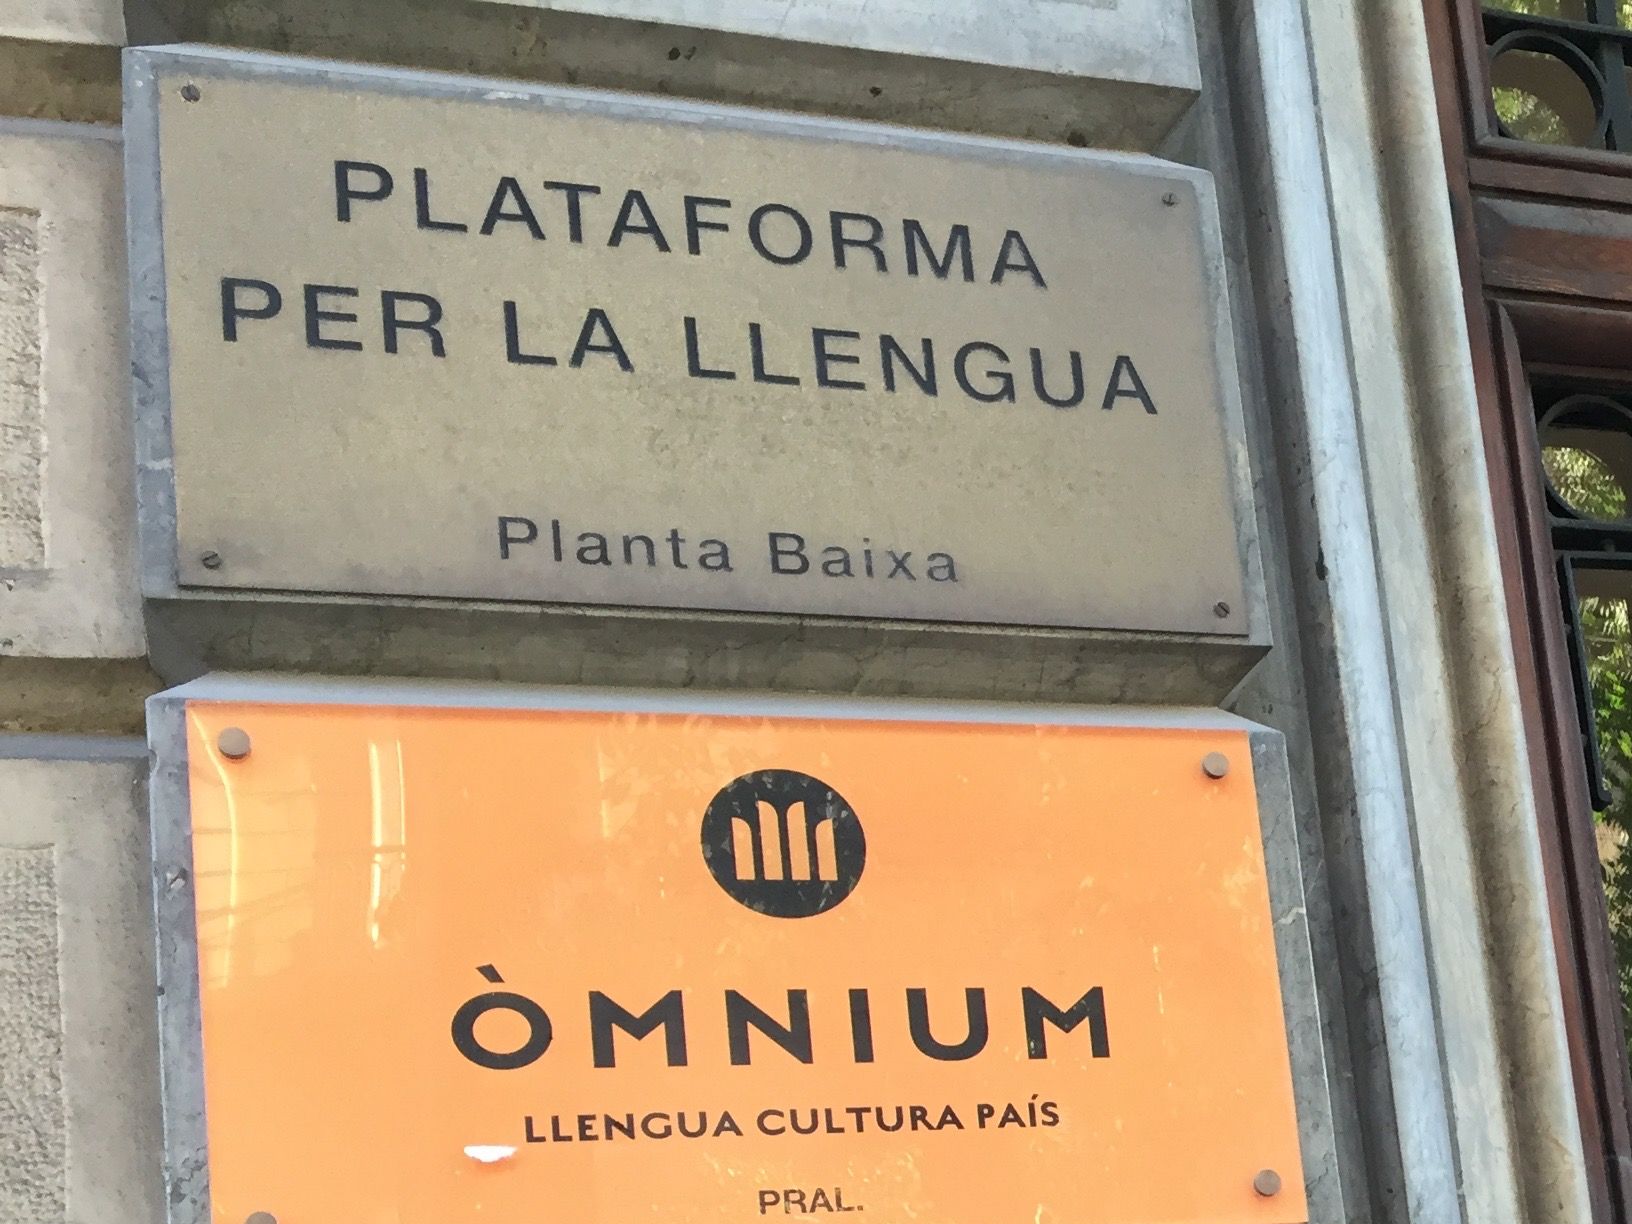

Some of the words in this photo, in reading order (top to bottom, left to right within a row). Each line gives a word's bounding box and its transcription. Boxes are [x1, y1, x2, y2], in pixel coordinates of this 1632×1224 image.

[334, 160, 1048, 289] PLATAFORMA
[220, 277, 447, 358] PER
[503, 300, 634, 373] LA
[683, 316, 1158, 415] LLENGUA
[497, 515, 735, 574] Planta
[768, 531, 960, 585] Baixa
[450, 963, 1110, 1070] ÒMNIUM
[524, 1108, 743, 1143] LLENGUA
[756, 1104, 964, 1136] CULTURA
[977, 1093, 1061, 1131] PAÍS
[758, 1187, 866, 1216] PRAL.
